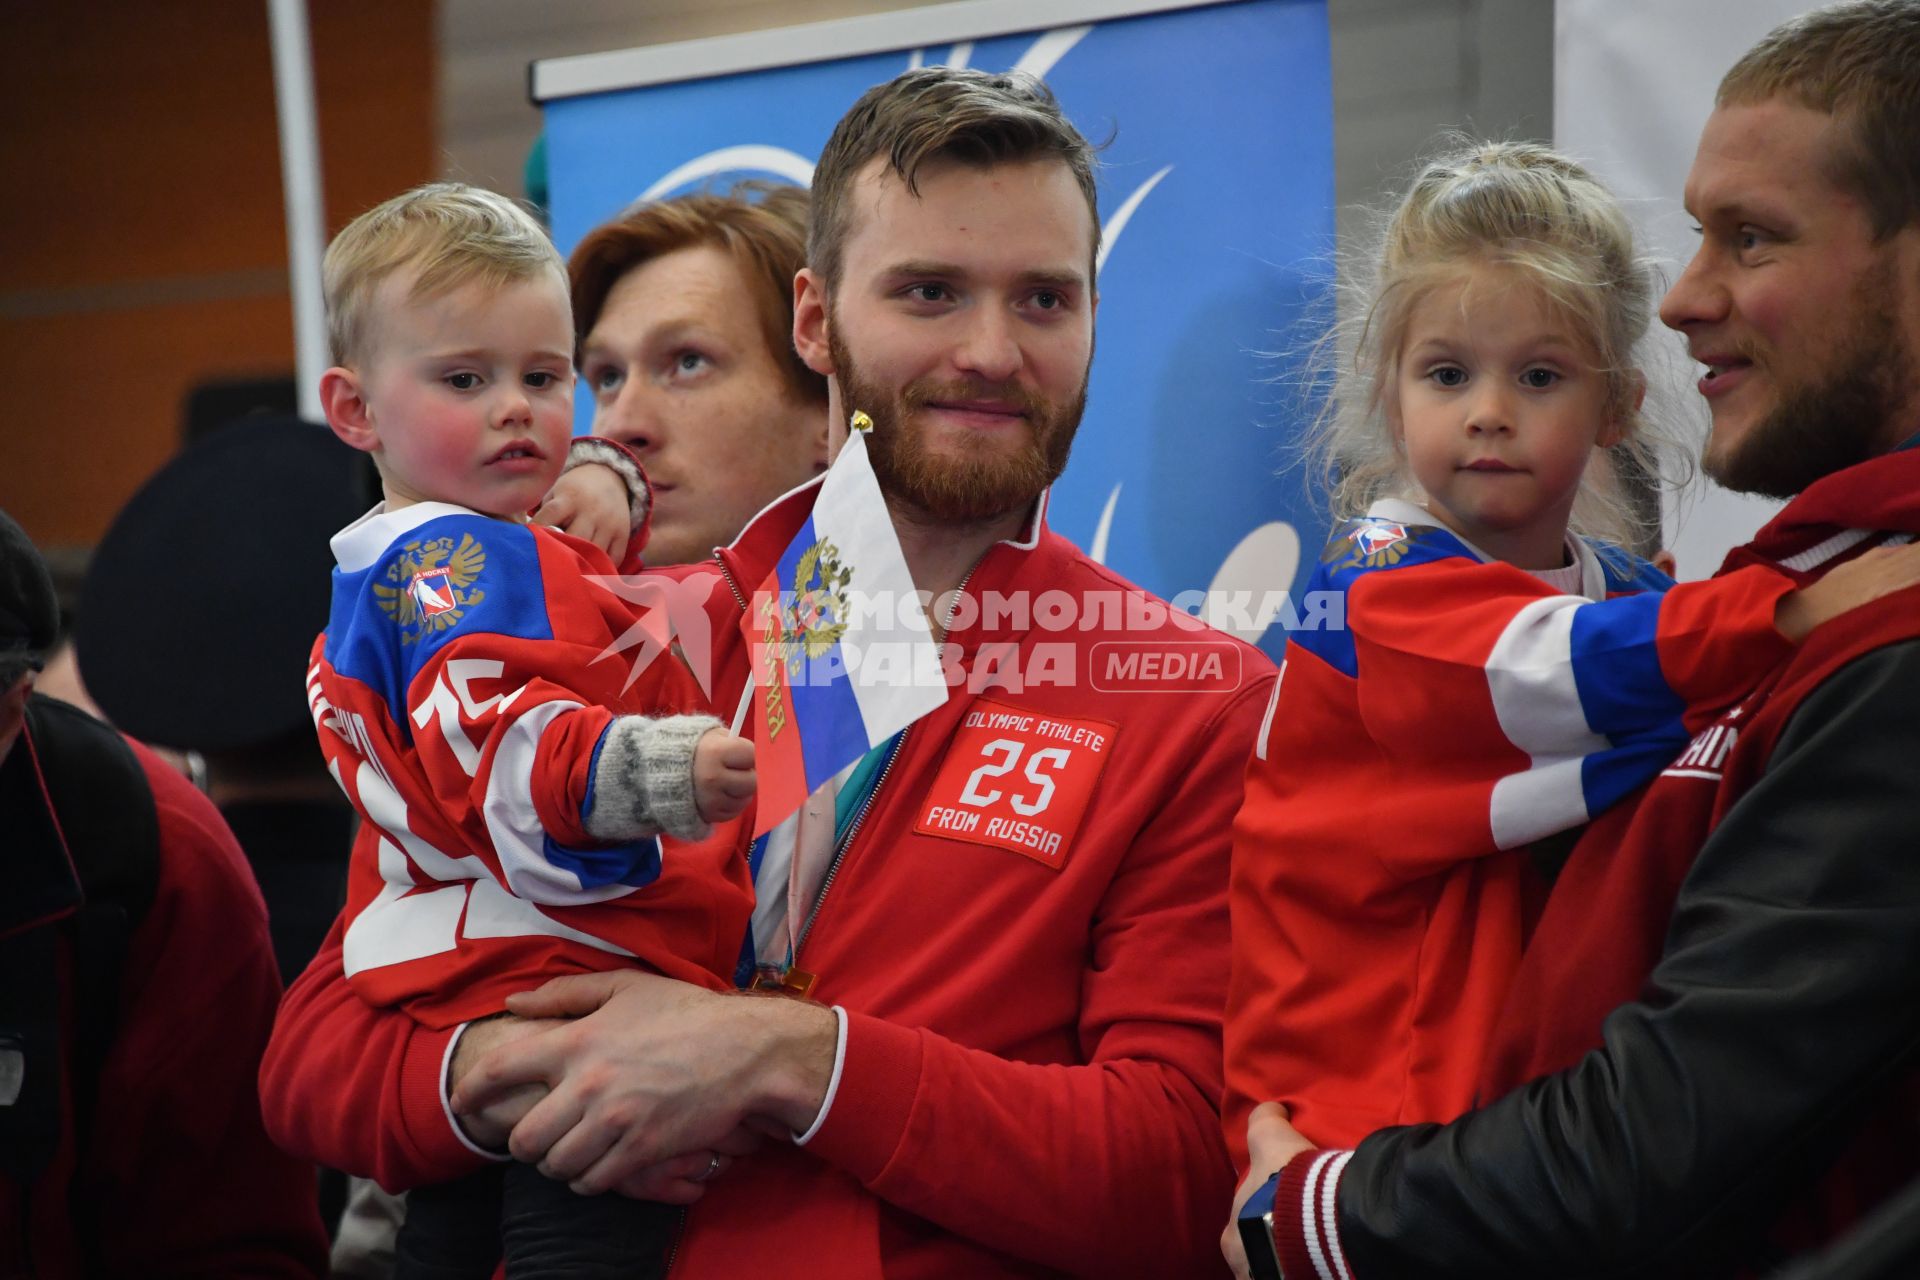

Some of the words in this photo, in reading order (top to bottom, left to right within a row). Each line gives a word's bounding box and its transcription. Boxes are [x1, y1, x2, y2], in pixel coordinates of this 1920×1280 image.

[965, 712, 1034, 732] OLYMPIC
[1036, 720, 1105, 752] ATHLETE
[959, 738, 1072, 817] 25
[926, 807, 980, 832] FROM
[985, 817, 1063, 856] RUSSIA
